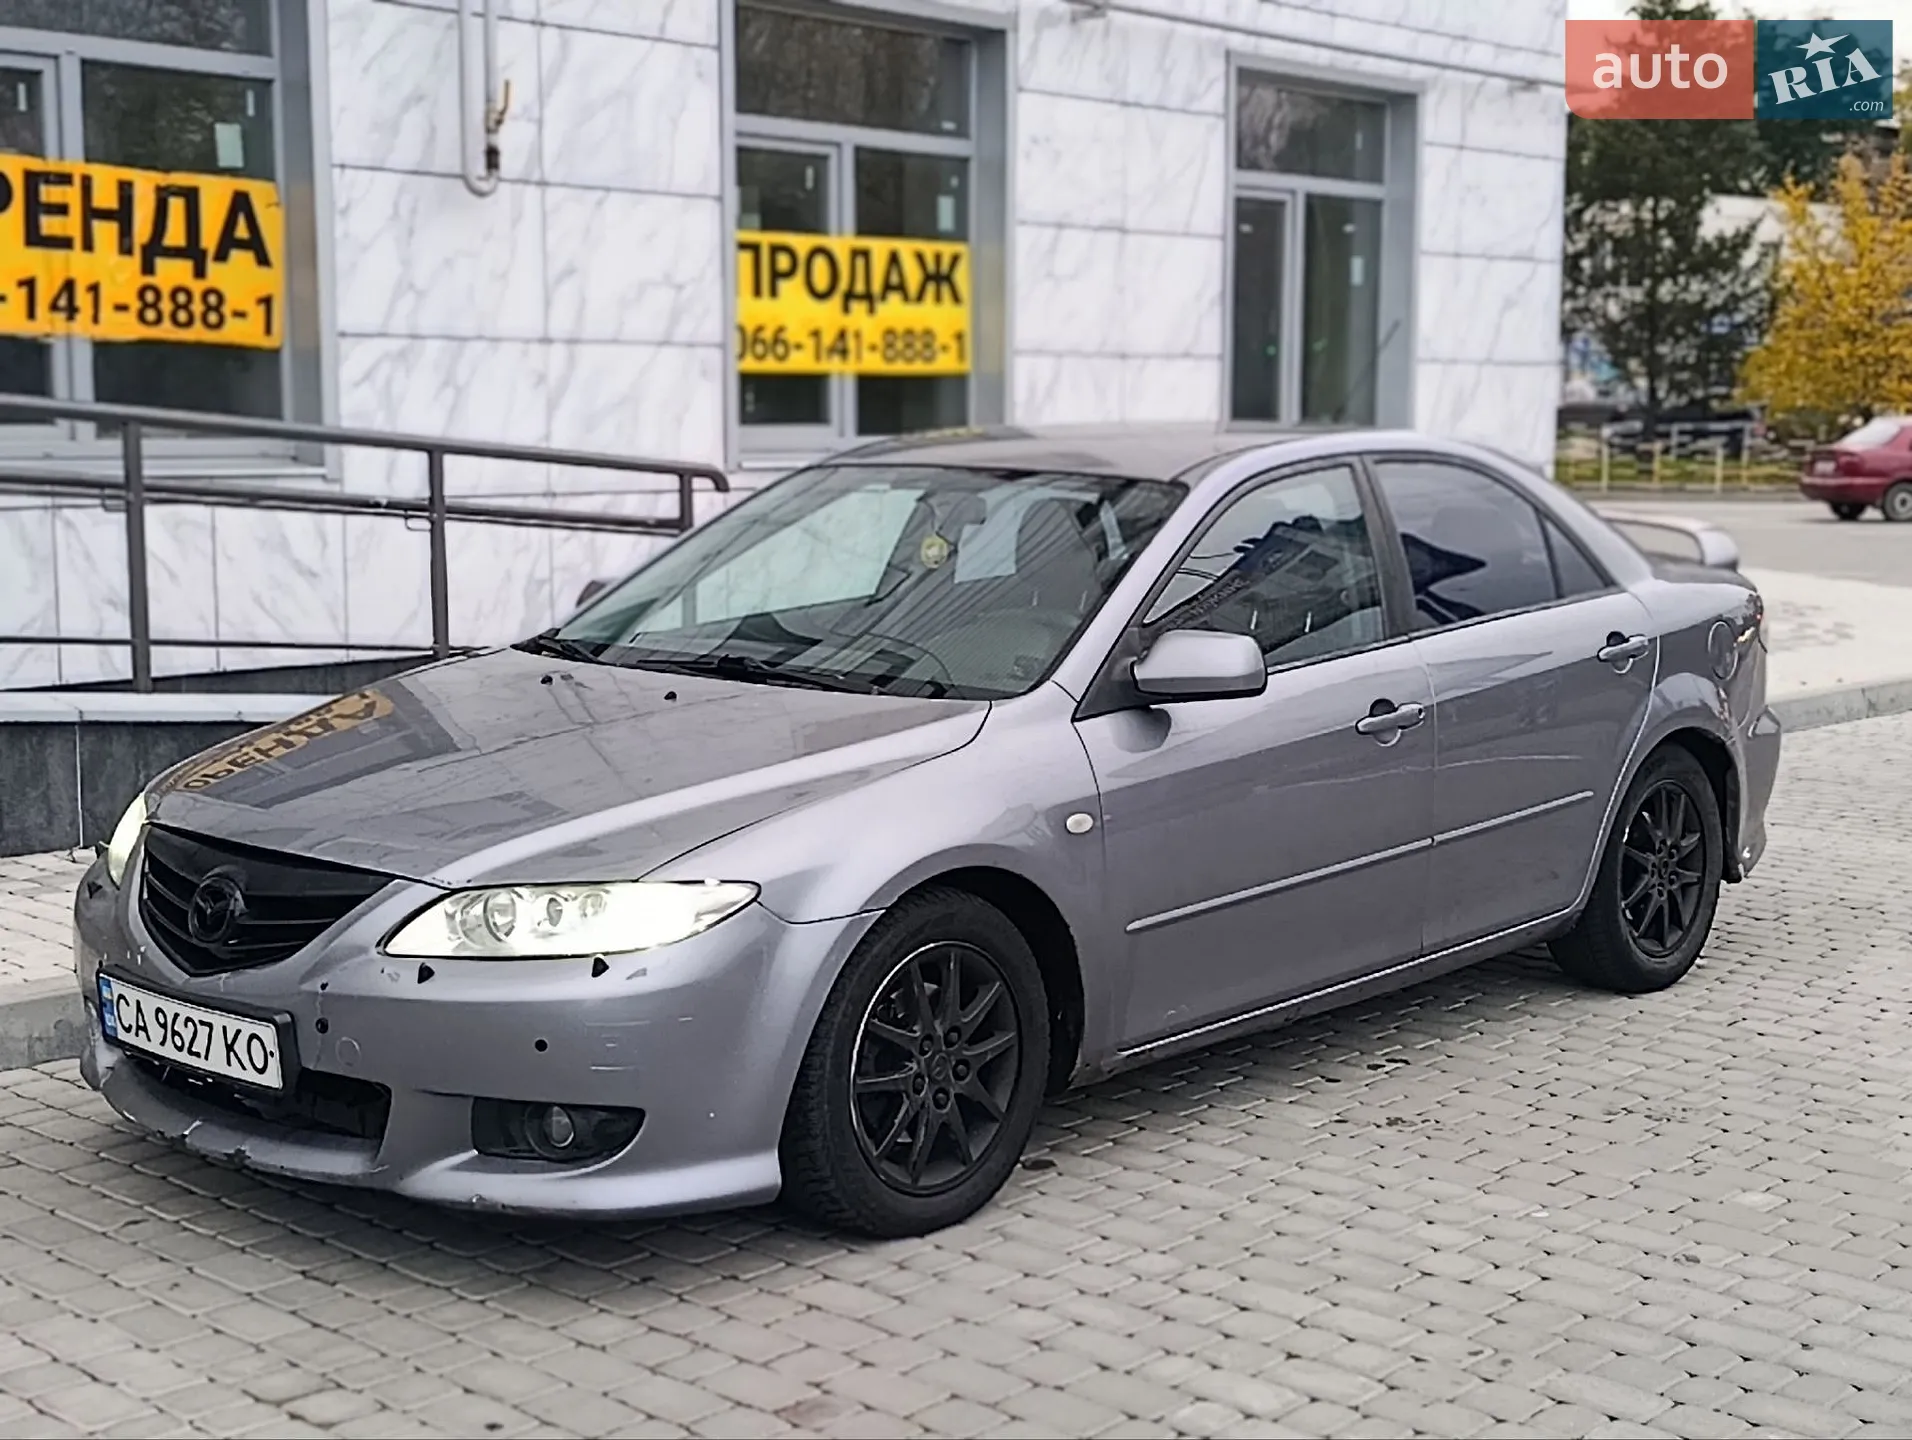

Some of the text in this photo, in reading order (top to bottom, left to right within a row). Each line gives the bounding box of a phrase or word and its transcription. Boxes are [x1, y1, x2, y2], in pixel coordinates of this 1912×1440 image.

[738, 241, 963, 315] ПРОДАЖ
[116, 993, 269, 1075] CA 9627 KO
